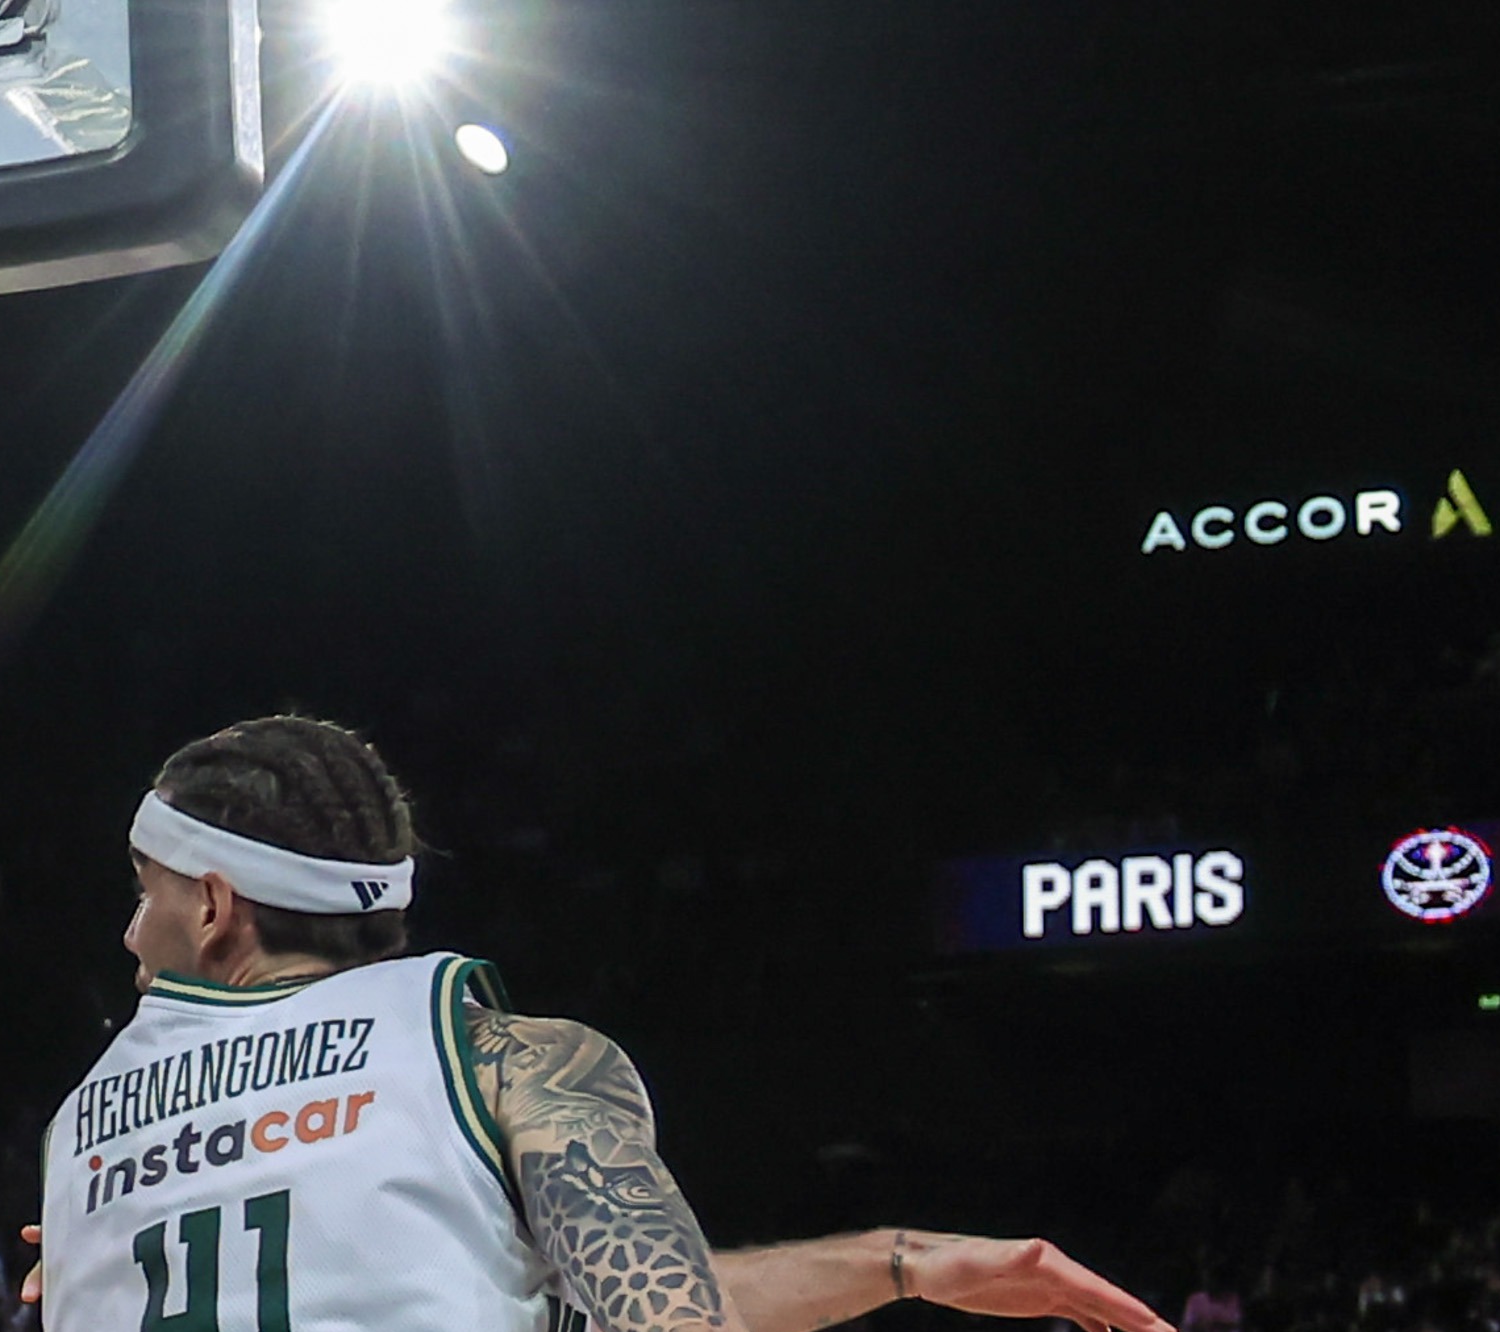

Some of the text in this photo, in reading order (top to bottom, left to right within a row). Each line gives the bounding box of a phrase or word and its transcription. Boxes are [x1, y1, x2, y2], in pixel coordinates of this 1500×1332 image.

[1142, 490, 1401, 554] ACCOR
[1023, 850, 1244, 939] PARIS
[73, 1017, 376, 1158] HERNANGOMEZ
[83, 1090, 376, 1214] instacar
